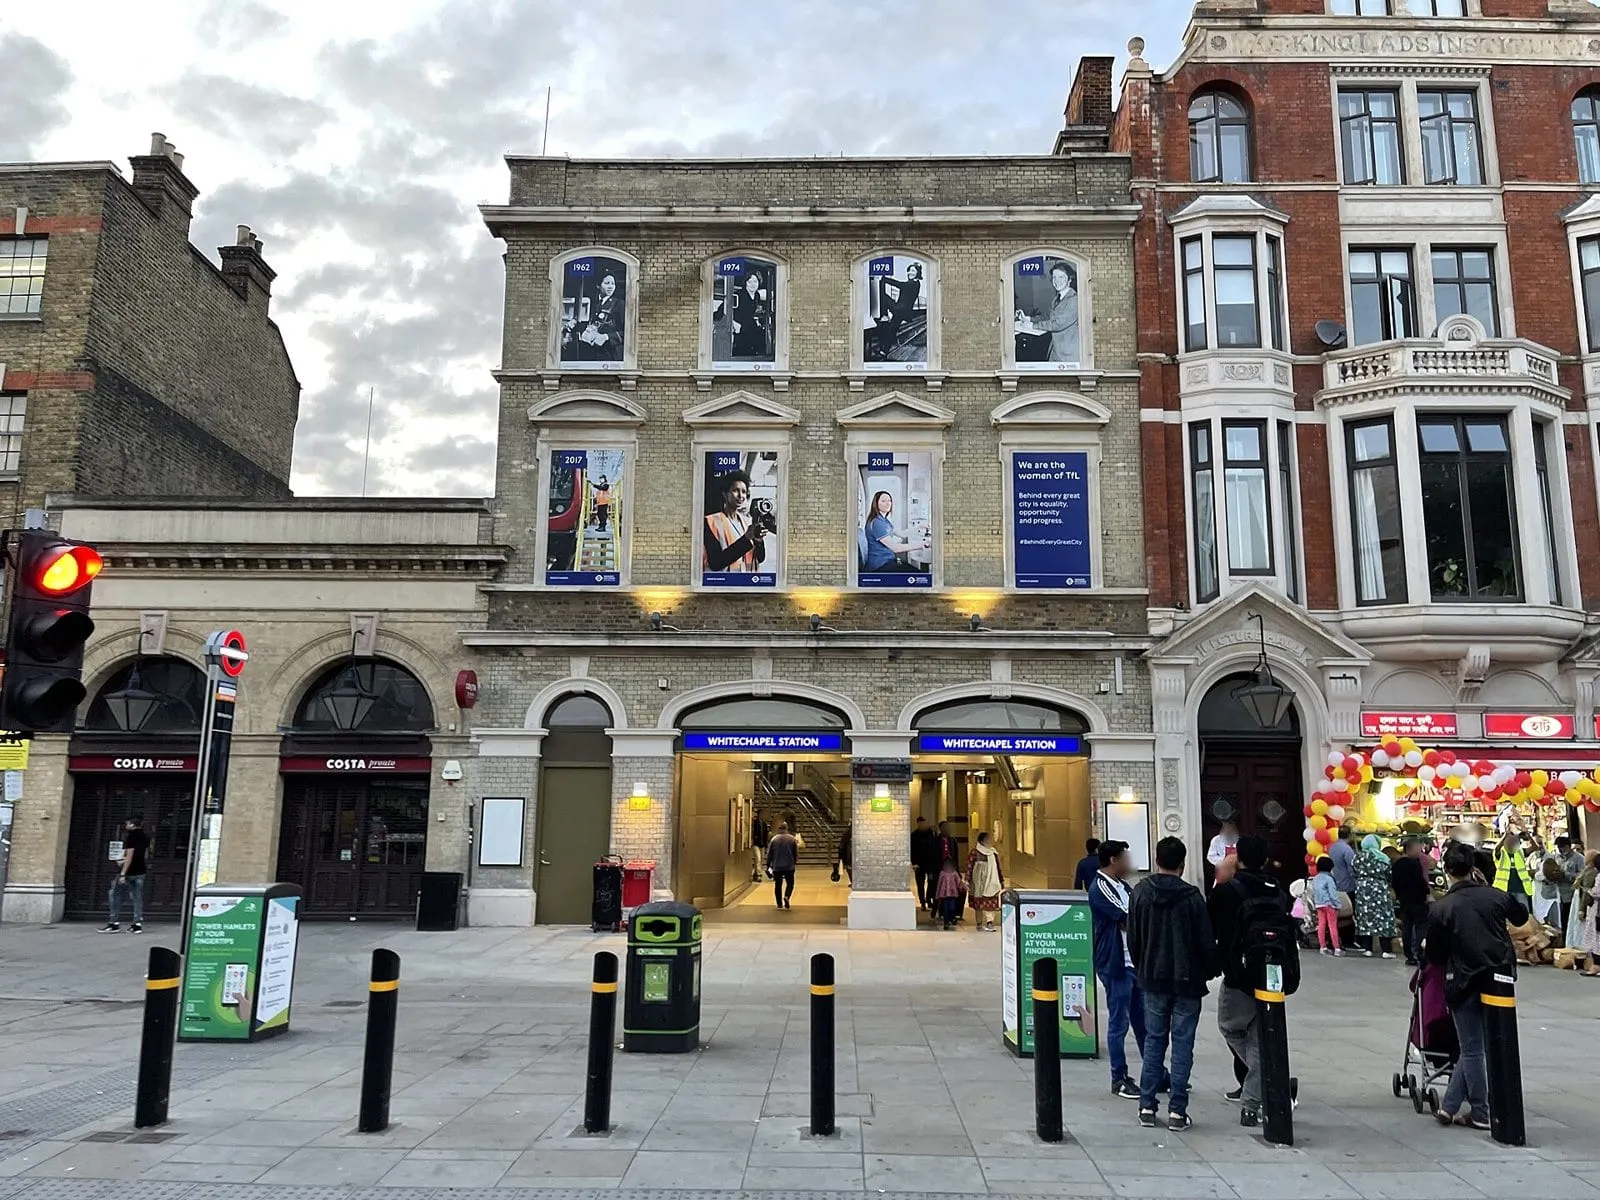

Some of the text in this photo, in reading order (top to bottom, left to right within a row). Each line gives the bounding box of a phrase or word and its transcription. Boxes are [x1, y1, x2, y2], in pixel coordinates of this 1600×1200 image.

[573, 263, 591, 272] 1962
[723, 263, 740, 272] 1974
[873, 263, 890, 272] 1978
[1022, 263, 1040, 272] 1979
[565, 456, 583, 464] 2017
[718, 457, 737, 465] 2018
[871, 458, 890, 466] 2018
[1018, 461, 1032, 469] We
[1051, 461, 1066, 469] the
[1053, 472, 1064, 480] of
[1065, 472, 1080, 480] TfL
[1040, 501, 1069, 509] equality,
[1019, 509, 1060, 517] opportunity
[707, 736, 819, 747] WHITECHAPEL STATION
[943, 738, 1057, 750] WHITECHAPEL STATION
[113, 758, 184, 769] COSTA pronto
[326, 759, 396, 770] COSTA pronto
